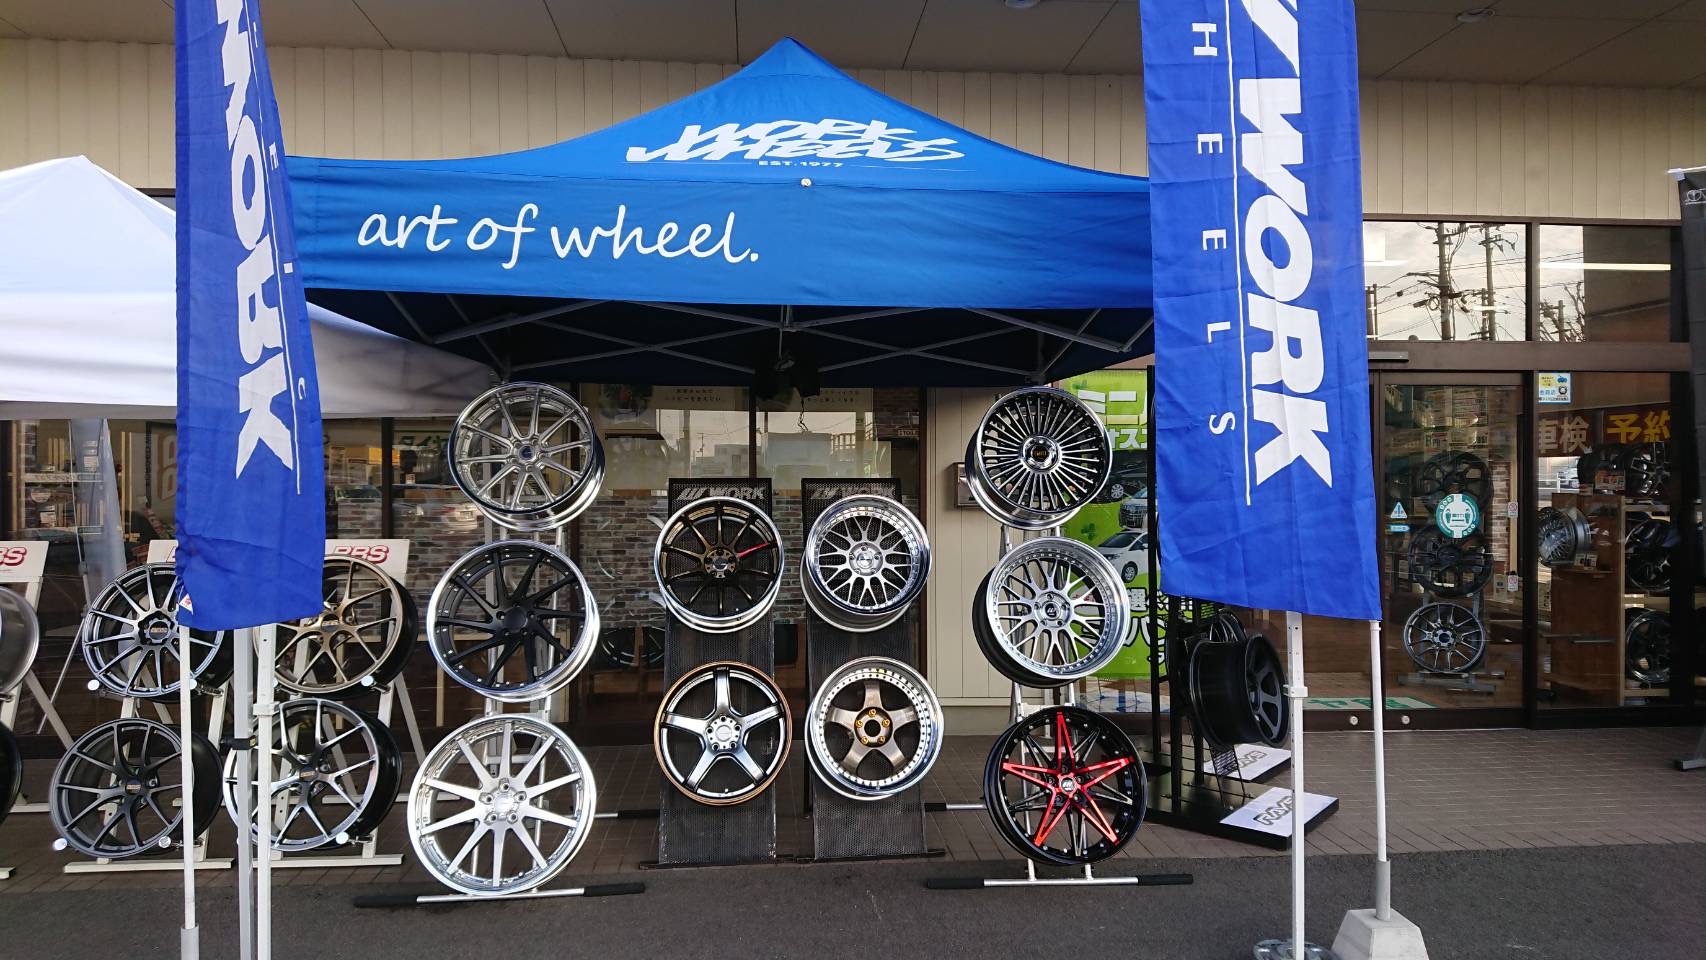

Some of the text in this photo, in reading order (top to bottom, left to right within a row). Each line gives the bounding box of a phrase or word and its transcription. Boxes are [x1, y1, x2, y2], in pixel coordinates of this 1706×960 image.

[681, 118, 917, 146] WORK
[357, 203, 759, 270] art of wheel.
[1239, 78, 1333, 489] WORK
[1606, 409, 1670, 444] 予約
[709, 486, 766, 501] WORK
